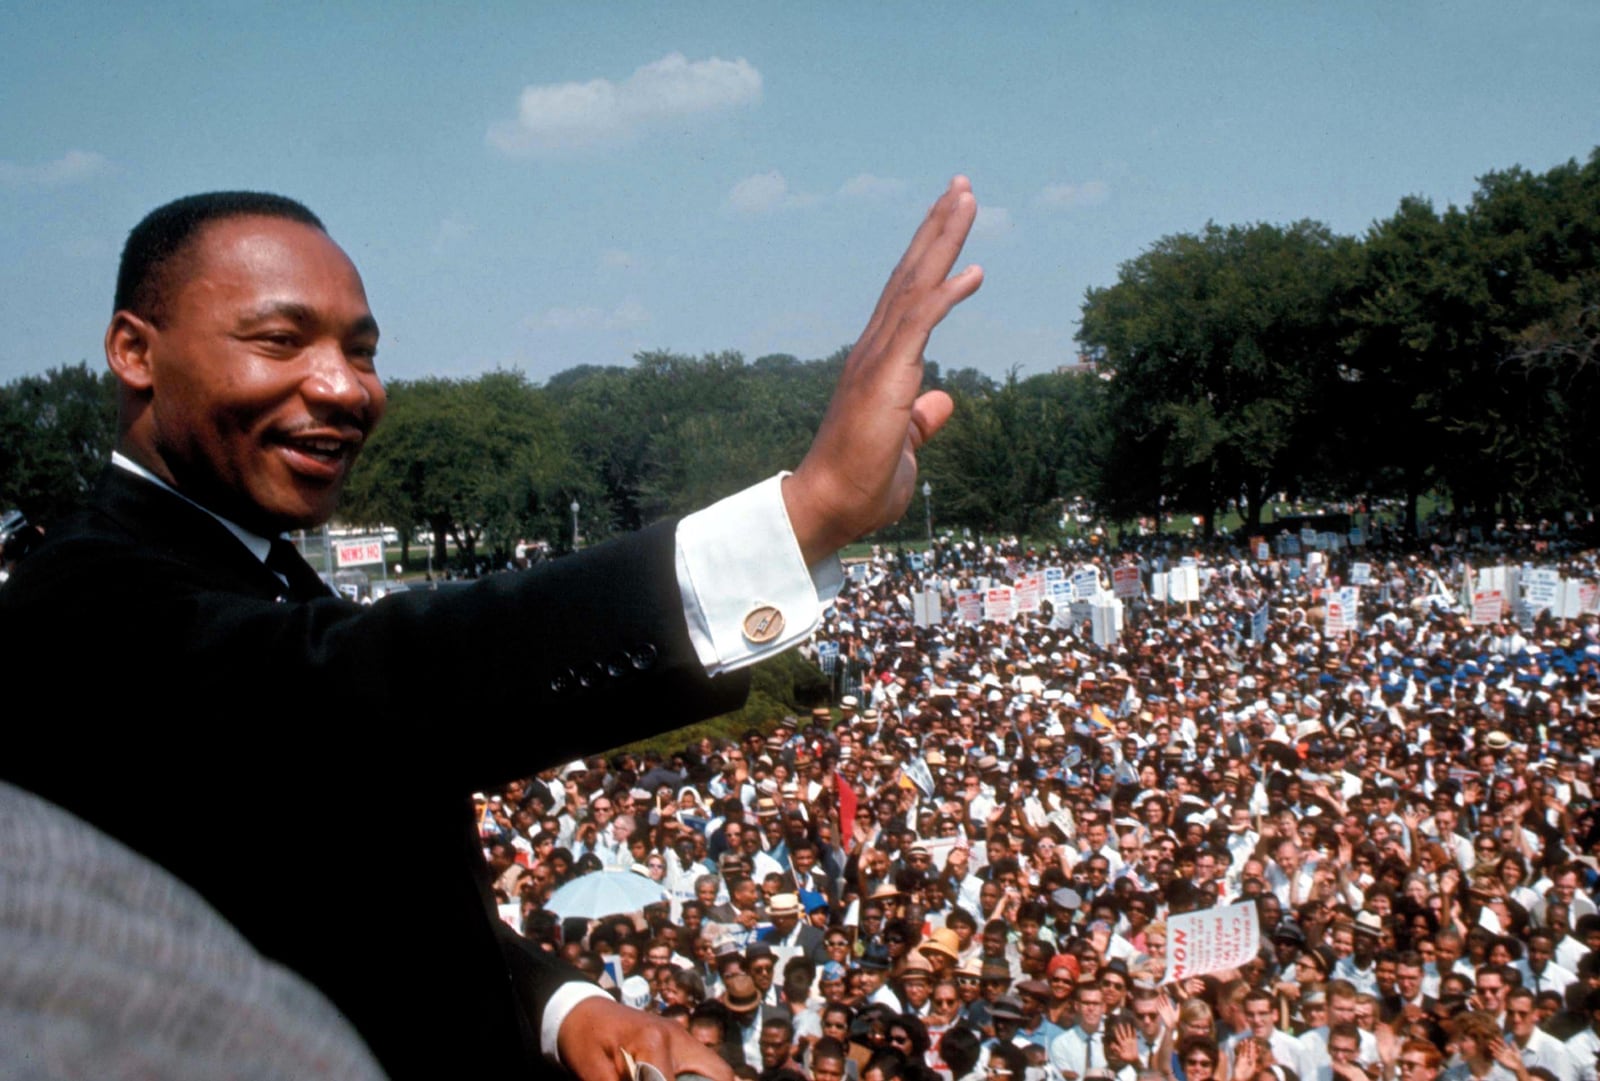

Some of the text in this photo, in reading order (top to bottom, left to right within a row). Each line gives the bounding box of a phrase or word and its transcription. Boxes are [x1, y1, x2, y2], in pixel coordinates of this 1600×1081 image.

[341, 544, 379, 561] NEWS HQ
[1172, 929, 1187, 981] NOW
